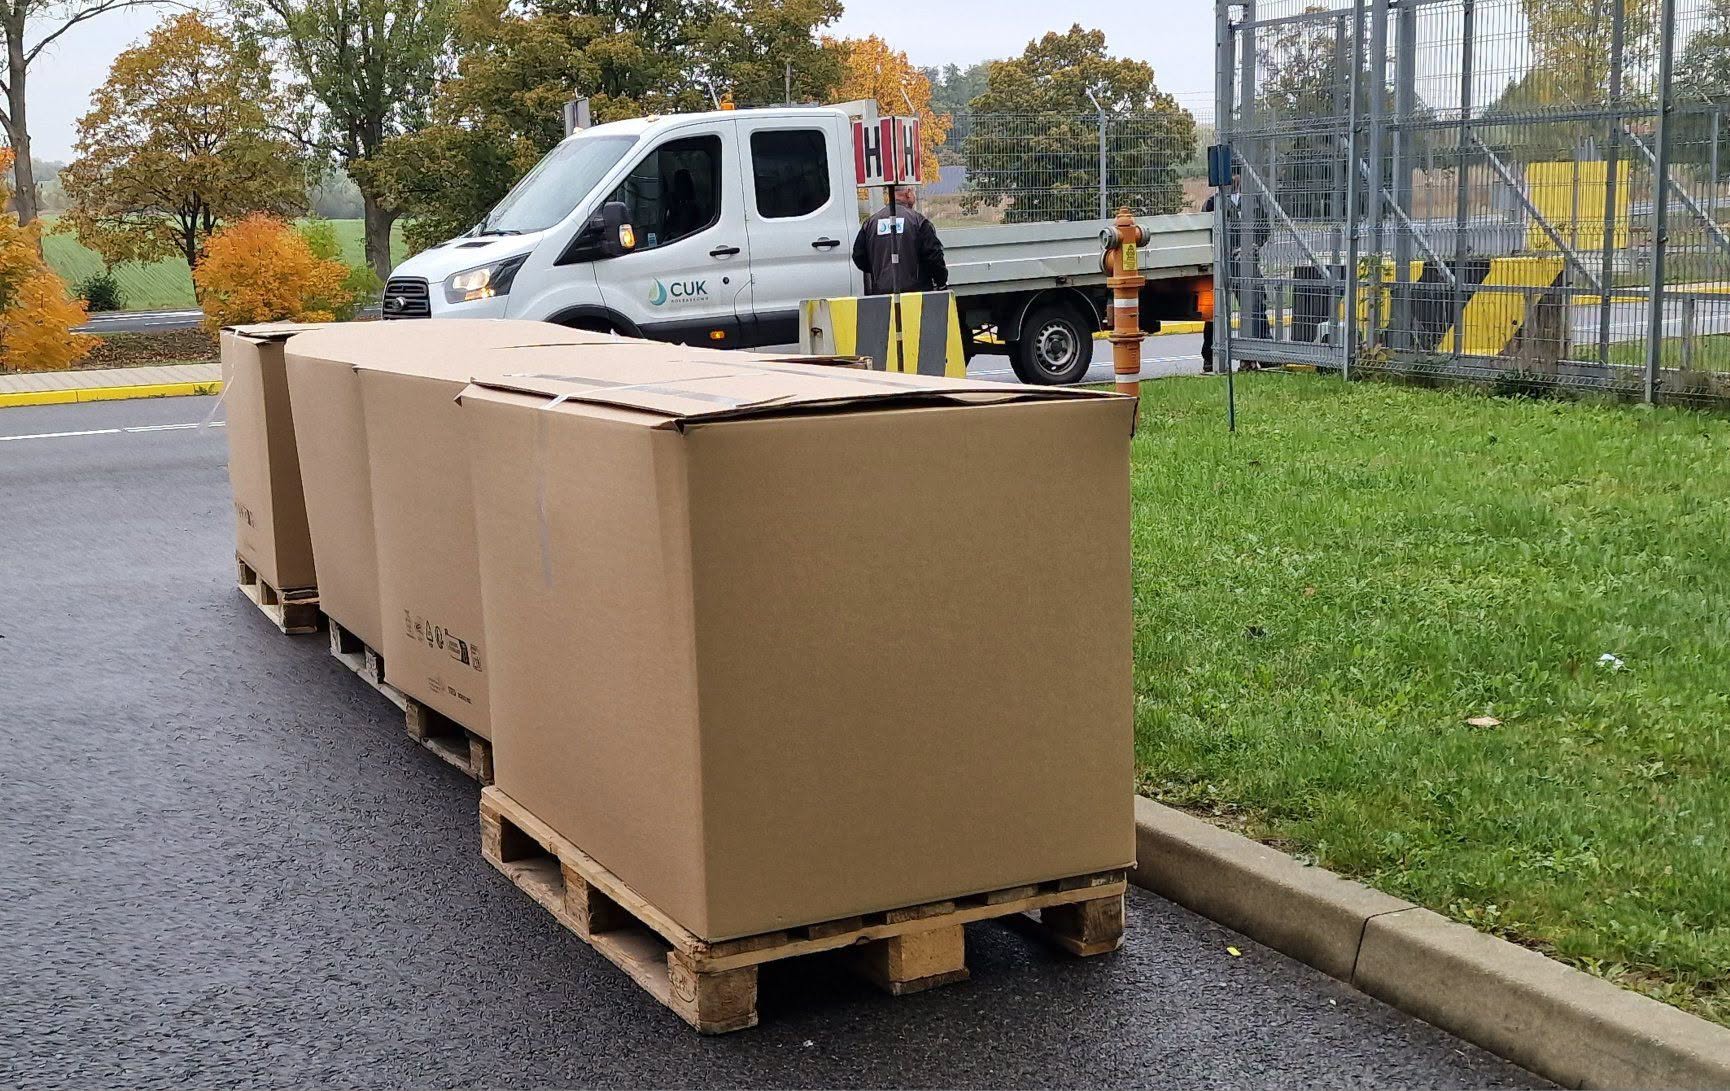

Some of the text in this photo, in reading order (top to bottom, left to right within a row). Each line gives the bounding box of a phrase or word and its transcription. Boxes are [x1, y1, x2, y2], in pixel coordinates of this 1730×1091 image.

[864, 126, 882, 178] H
[903, 125, 915, 177] H
[670, 280, 708, 297] CUK
